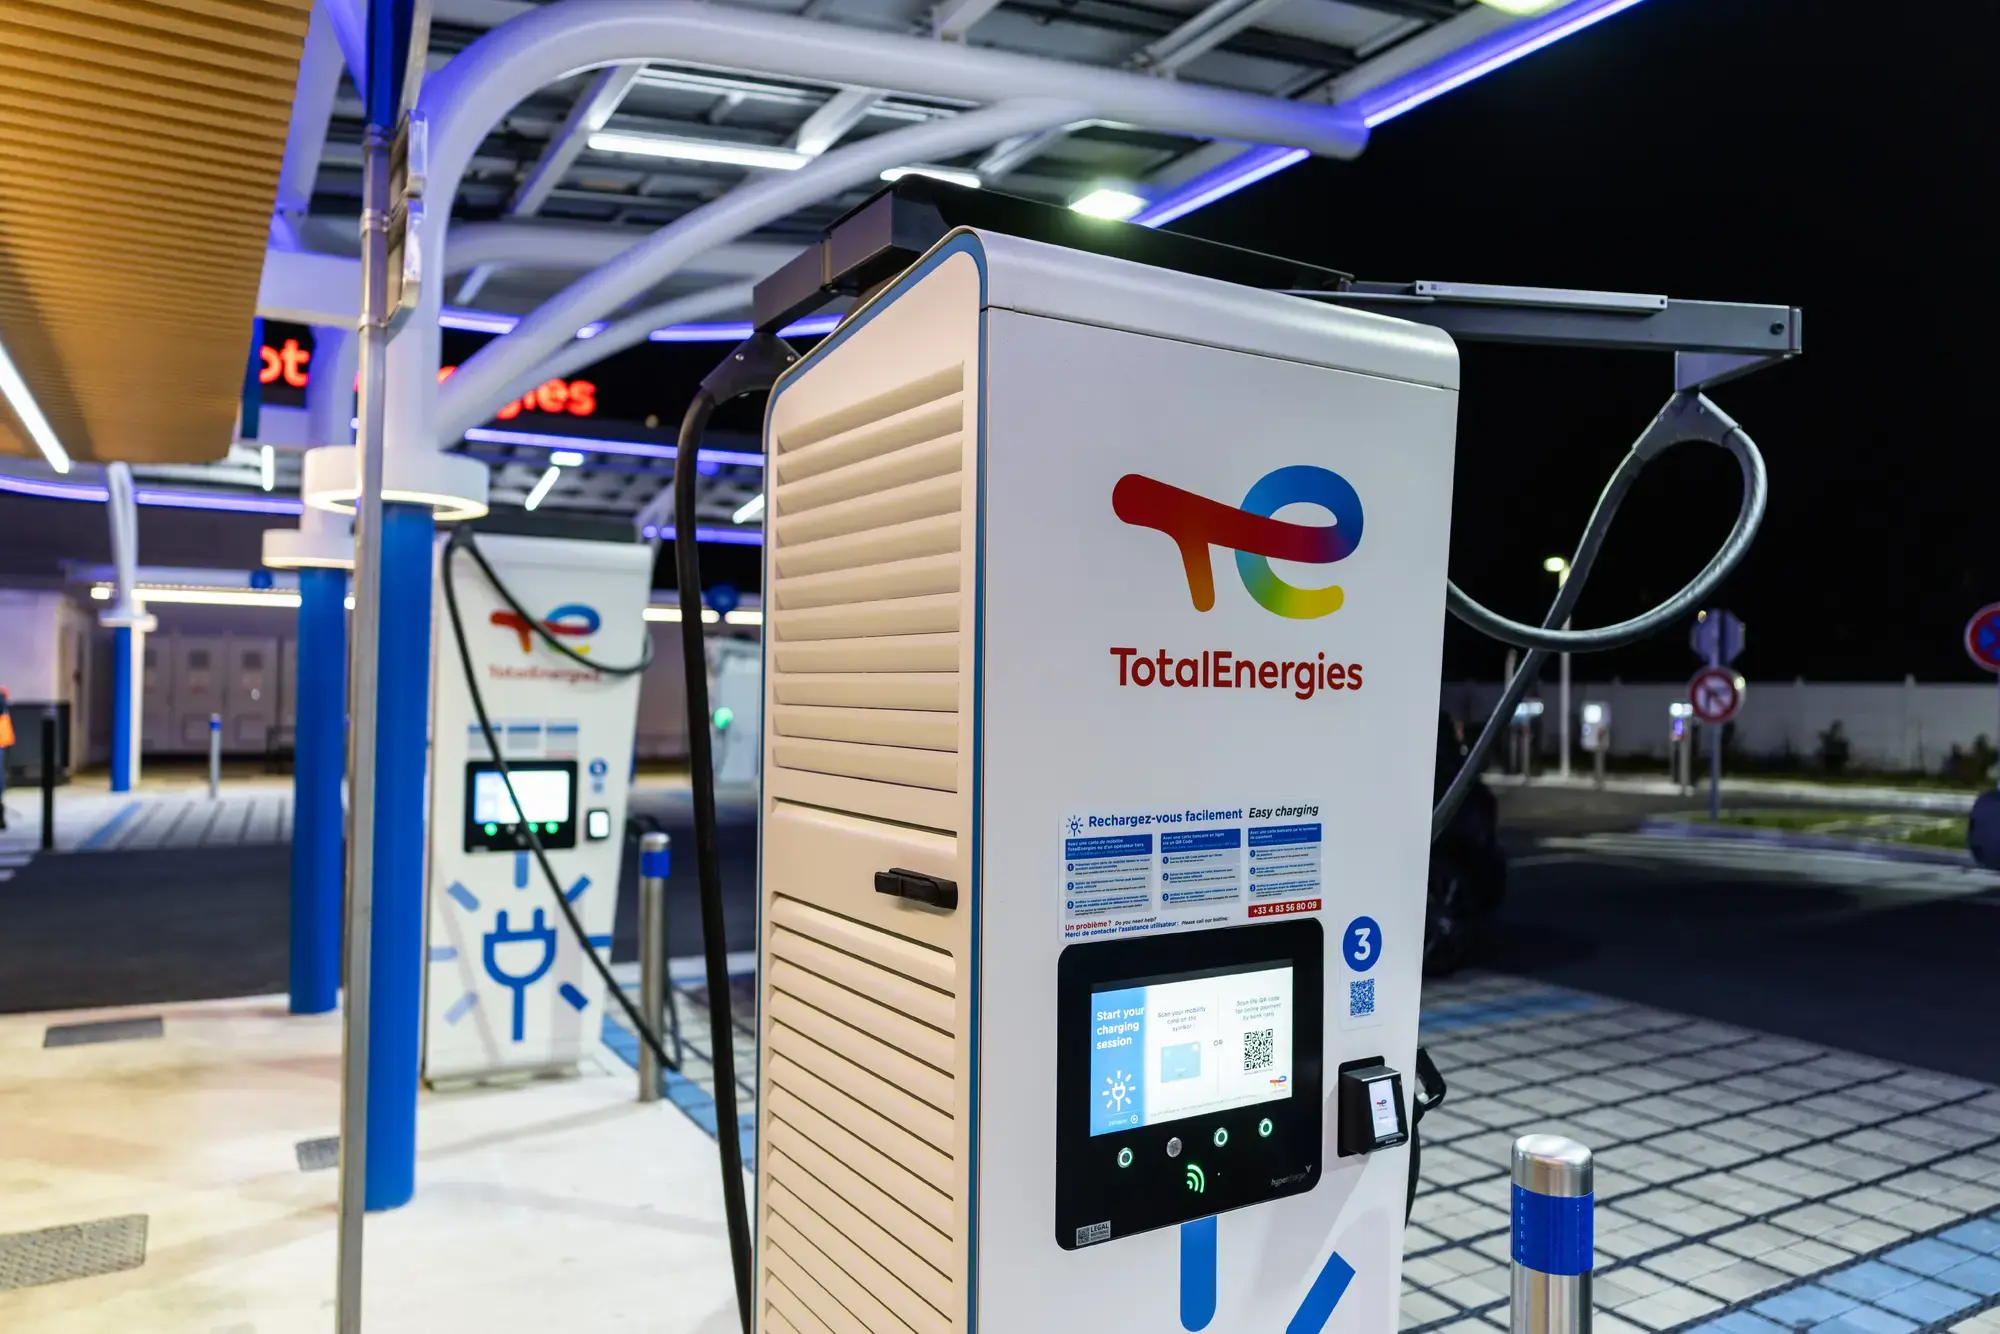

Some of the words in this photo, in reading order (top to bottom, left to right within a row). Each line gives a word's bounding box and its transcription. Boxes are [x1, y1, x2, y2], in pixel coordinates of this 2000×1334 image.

[1110, 647, 1363, 700] TotalEnergies
[1088, 812, 1183, 828] Rechargez-vous
[1185, 808, 1243, 822] facilement
[1248, 807, 1273, 820] Easy
[1275, 804, 1319, 818] charging
[1253, 906, 1267, 915] +33
[1268, 905, 1274, 914] 4
[1275, 904, 1284, 913] 83
[1286, 903, 1295, 912] 56
[1296, 902, 1306, 911] 80
[1307, 900, 1317, 910] 09
[1065, 930, 1080, 938] Merci
[1090, 927, 1117, 936] contacter
[1118, 924, 1149, 933] l'assistance
[1354, 927, 1371, 961] 3
[1096, 1008, 1121, 1022] Start
[1123, 1006, 1145, 1020] your
[1096, 1021, 1140, 1036] charging
[1096, 1036, 1132, 1050] session
[1090, 1222, 1109, 1232] LEGAL
